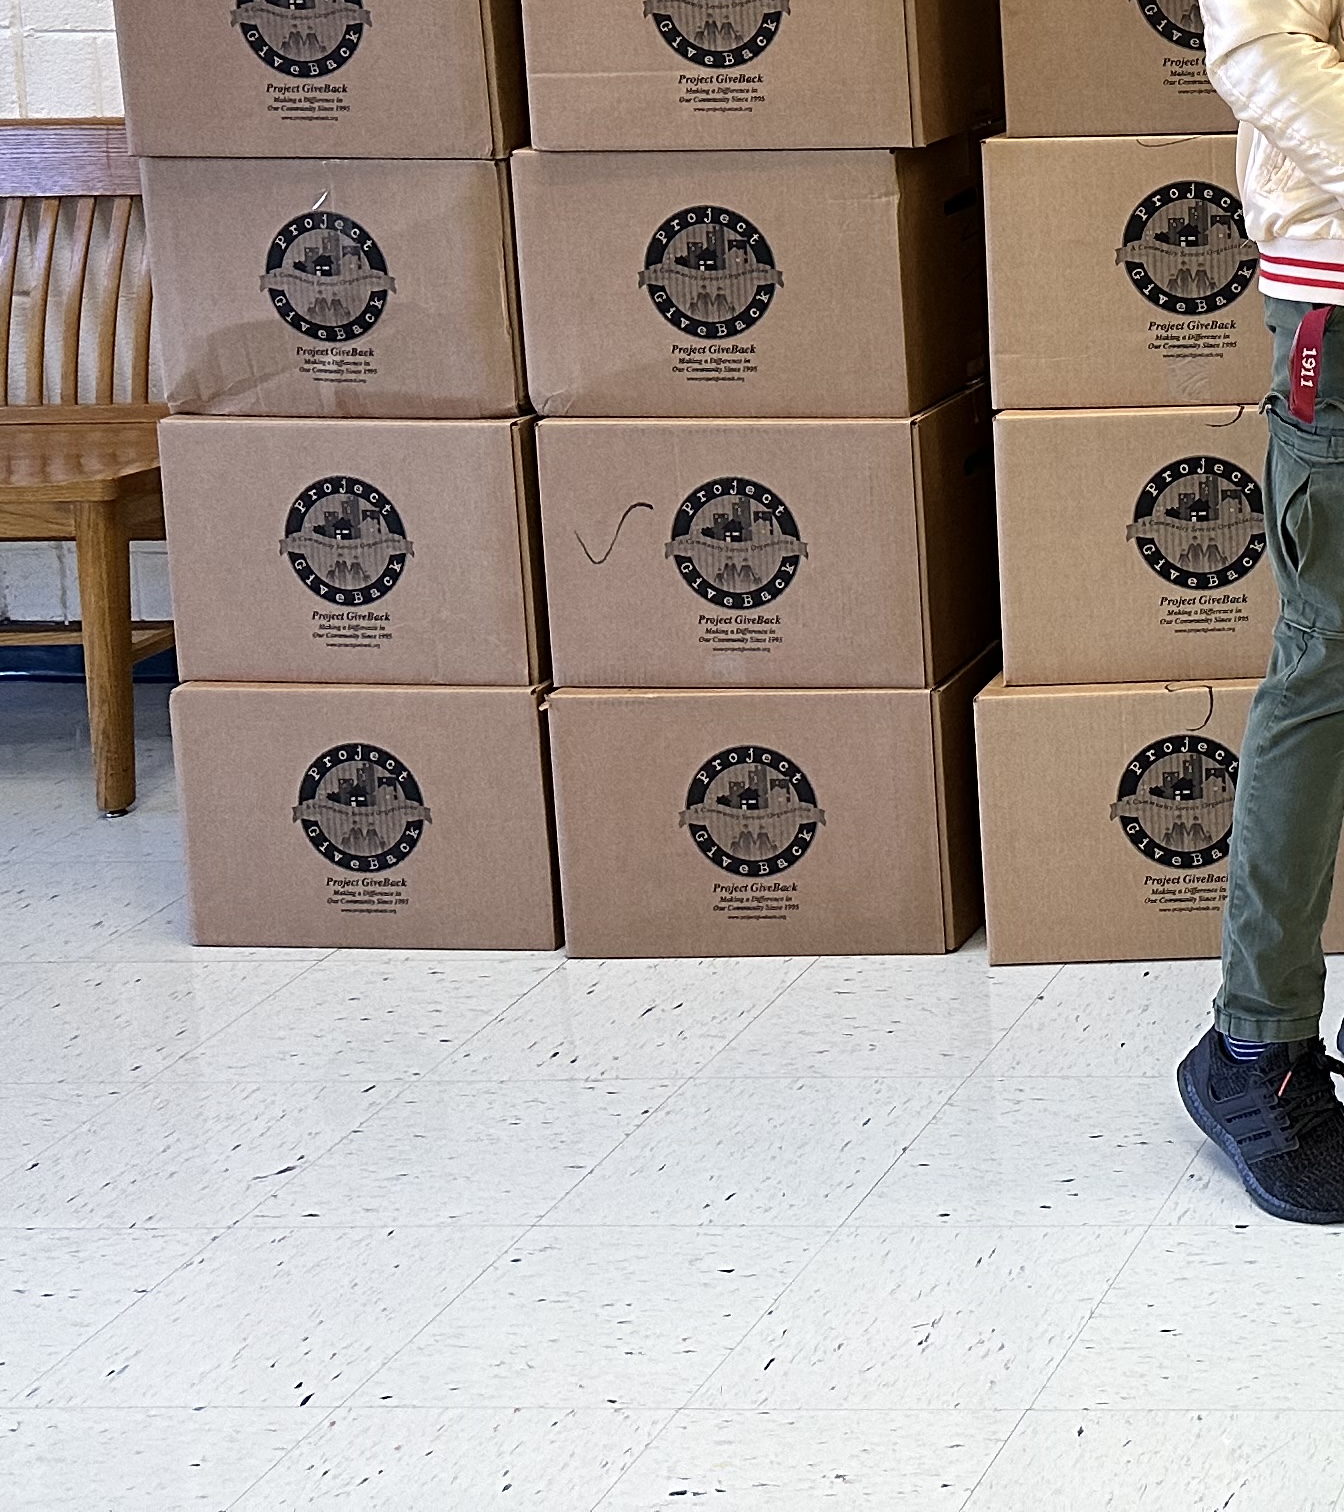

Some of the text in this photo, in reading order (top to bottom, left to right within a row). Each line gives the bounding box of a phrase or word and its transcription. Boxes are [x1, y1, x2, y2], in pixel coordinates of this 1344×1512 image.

[247, 30, 360, 75] GiveBack
[660, 19, 778, 65] GiveBack
[677, 73, 763, 86] Project GiveBack
[1161, 57, 1200, 69] Project
[265, 83, 348, 95] Project GiveBack
[1134, 182, 1245, 221] Project
[274, 213, 374, 251] Project
[655, 207, 761, 245] Project
[1132, 266, 1254, 312] GiveBack
[275, 295, 385, 339] GiveBack
[654, 291, 771, 336] GiveBack
[1147, 319, 1236, 333] Project GiveBack
[1300, 347, 1317, 388] 1911
[294, 477, 392, 515] Project
[1145, 457, 1256, 497] Project
[681, 479, 786, 516] Project
[294, 559, 403, 603] GiveBack
[1142, 540, 1265, 587] GiveBack
[680, 562, 796, 607] GiveBack
[1158, 593, 1248, 608] Project GiveBack
[307, 745, 409, 782] Project
[696, 747, 803, 785] Project
[1129, 736, 1240, 776] Project
[308, 826, 420, 870] GiveBack
[695, 829, 813, 874] GiveBack
[1126, 819, 1232, 866] GiveBa
[712, 882, 798, 895] Project GiveBack
